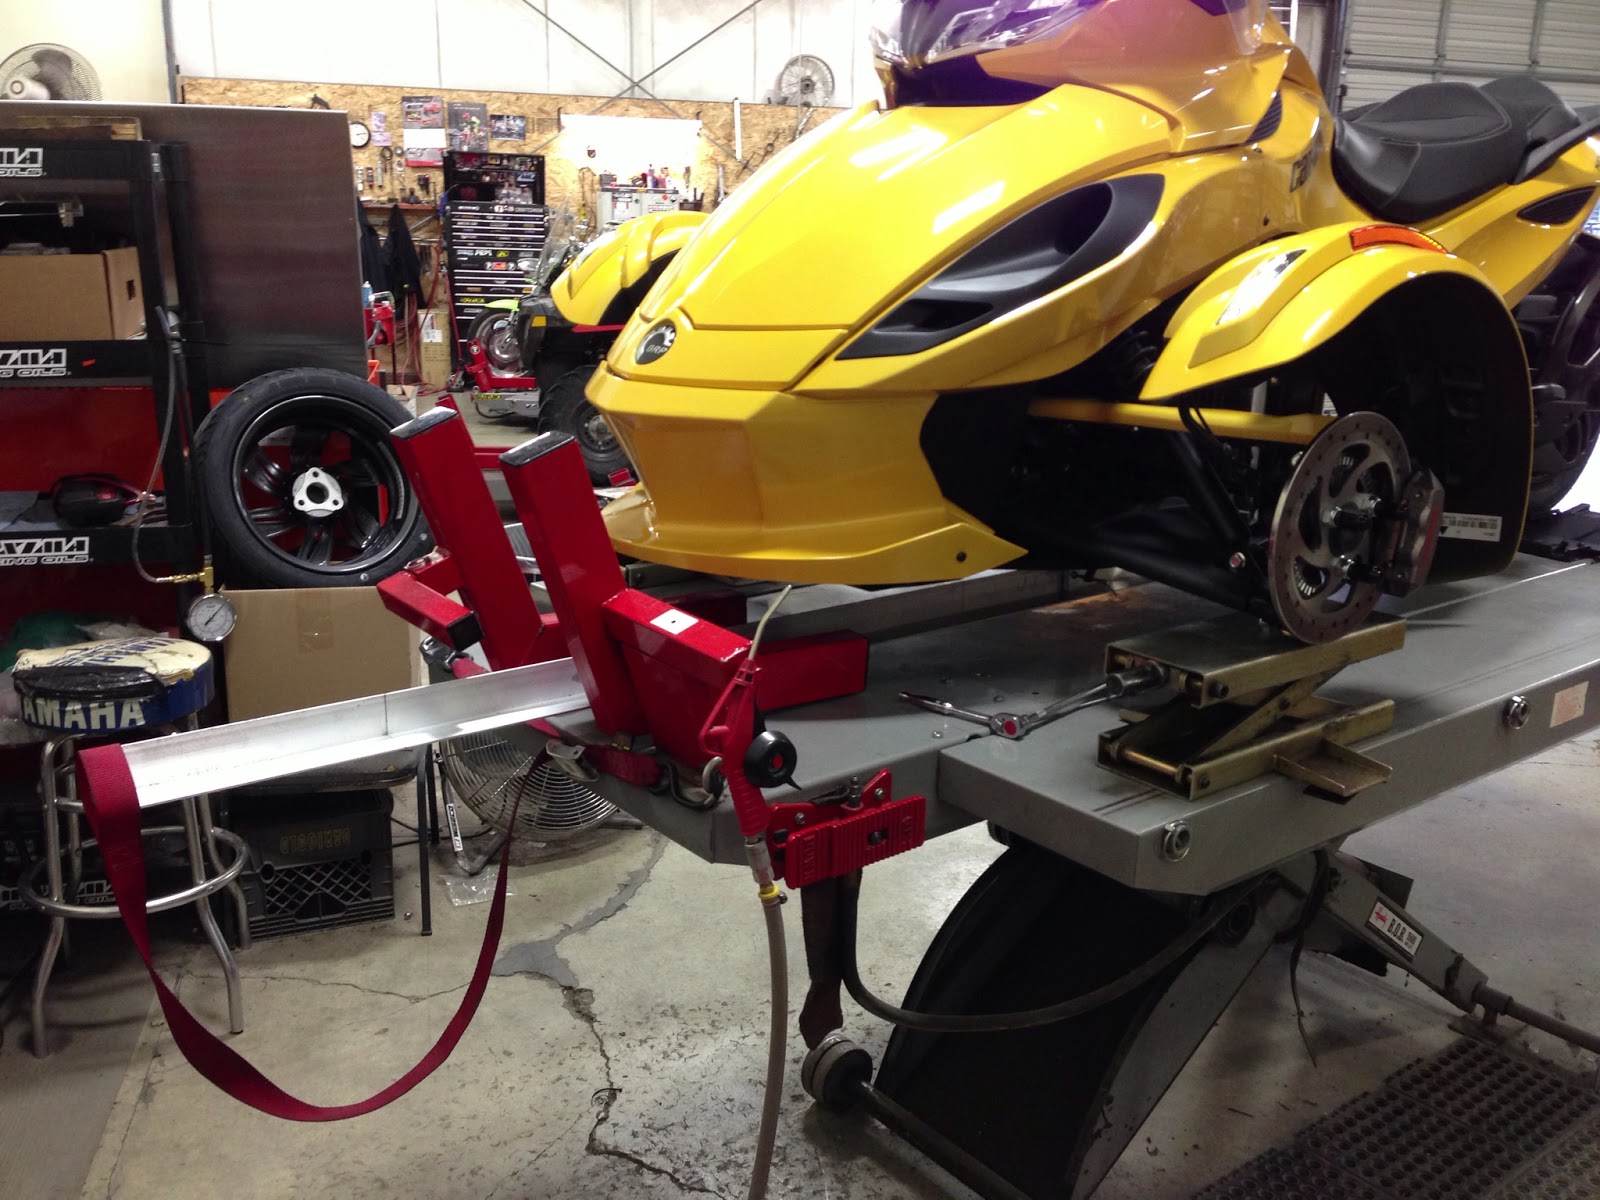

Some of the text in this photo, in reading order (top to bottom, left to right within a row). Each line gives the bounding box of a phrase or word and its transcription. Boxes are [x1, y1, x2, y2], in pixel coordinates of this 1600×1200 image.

[646, 344, 668, 355] BRP
[17, 368, 67, 377] OILS
[41, 554, 89, 565] OILS
